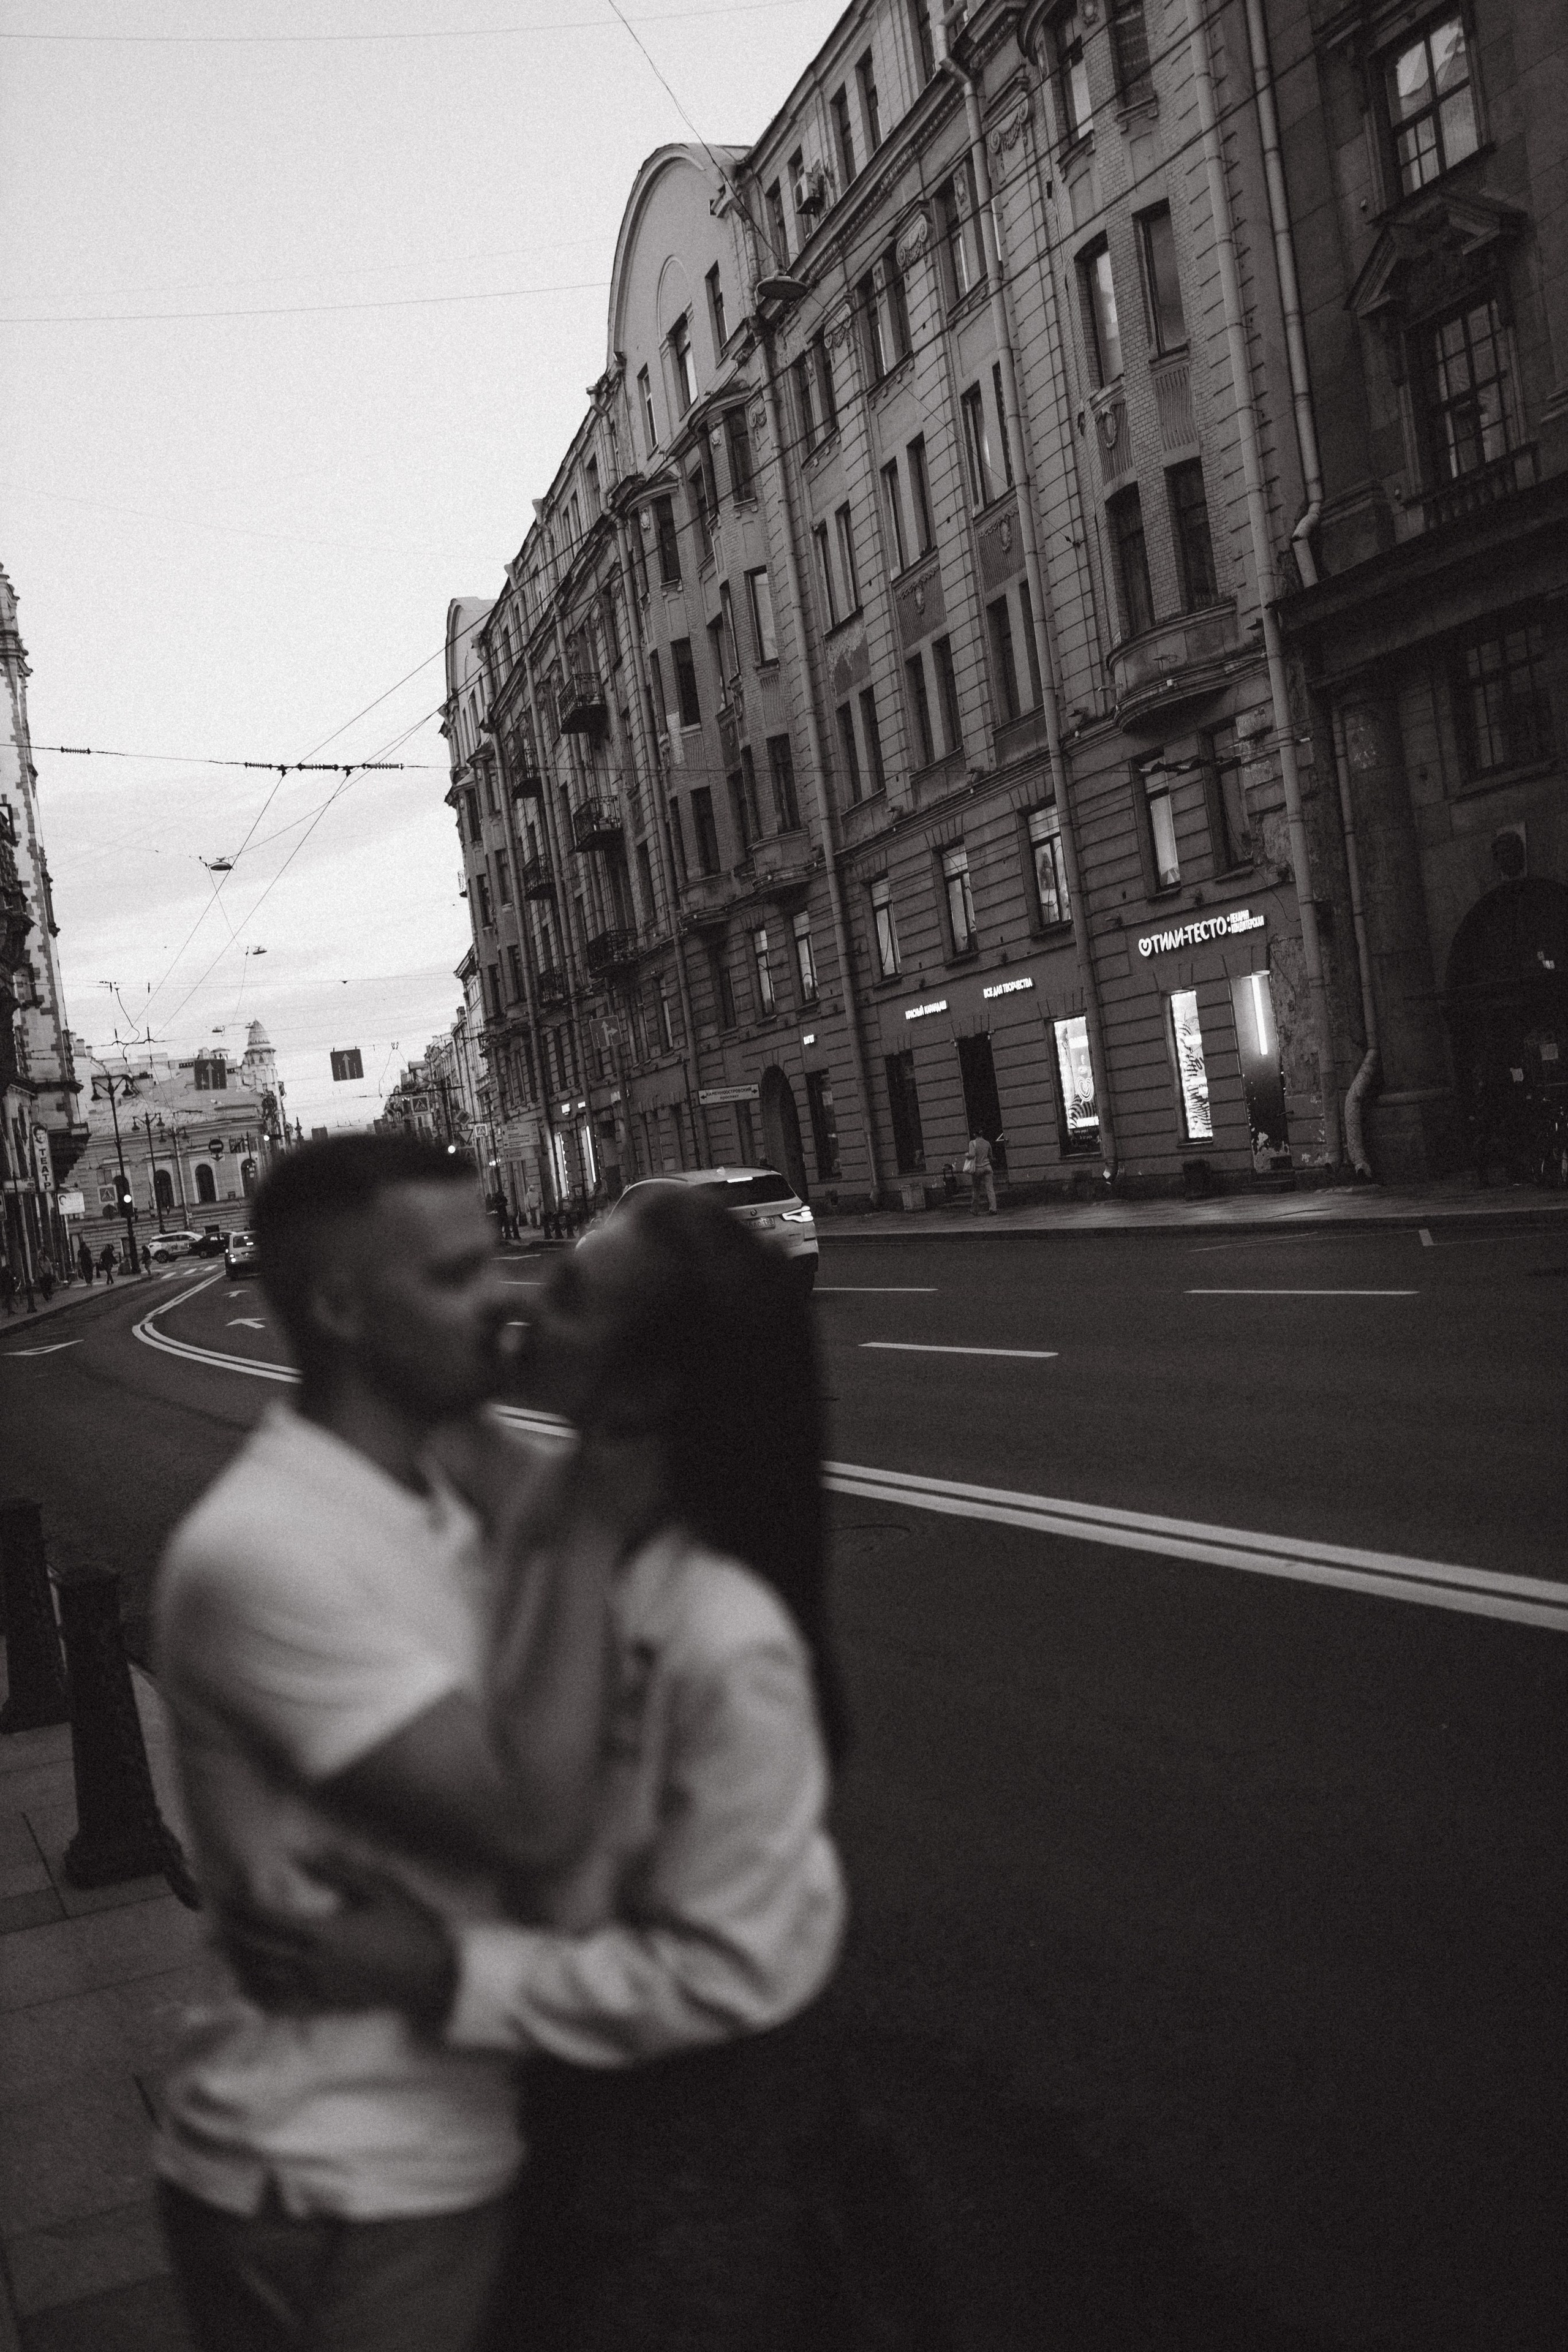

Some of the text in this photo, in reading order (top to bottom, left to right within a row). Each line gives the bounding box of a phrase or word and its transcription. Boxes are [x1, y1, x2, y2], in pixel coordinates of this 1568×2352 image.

[1230, 909, 1250, 924] ПЕКАРНЯ
[1151, 916, 1227, 954] ТИЛИ-ТЕСТО
[993, 984, 1003, 997] ДЛЯ
[1002, 977, 1033, 993] ТВОРЧЕСТВА
[706, 1087, 752, 1096] КАМЕННООСТРОВСКИЙ
[39, 1148, 51, 1190] ТЕАТР
